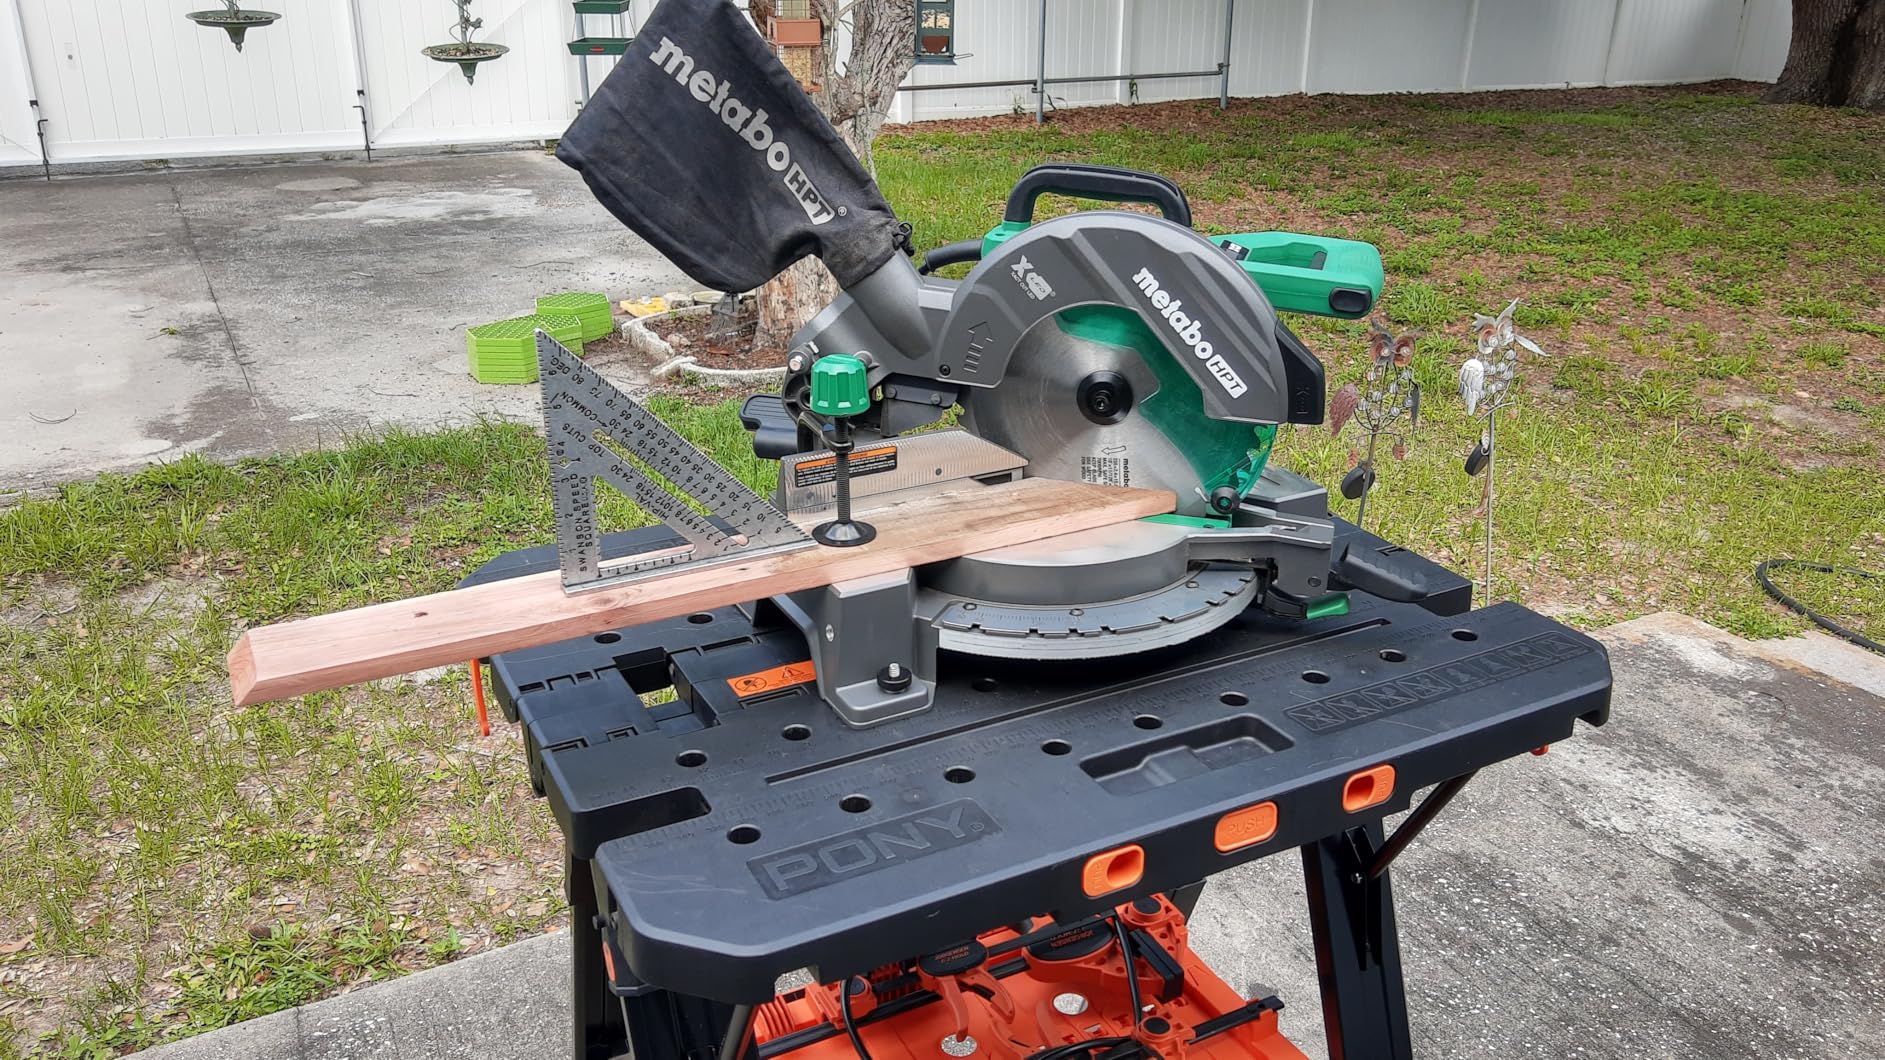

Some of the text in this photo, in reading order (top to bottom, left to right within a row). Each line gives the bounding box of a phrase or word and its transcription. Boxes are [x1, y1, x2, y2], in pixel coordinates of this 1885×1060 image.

[648, 36, 831, 219] metabo HPT
[1132, 267, 1242, 391] metabo HPT
[550, 355, 570, 375] DEG.
[572, 374, 584, 384] 80
[589, 387, 602, 398] 75
[560, 391, 598, 421] COMMON
[606, 400, 617, 410] 70
[620, 410, 632, 420] 65
[609, 418, 621, 429] 30
[633, 420, 645, 430] 60
[621, 428, 633, 438] 24
[645, 430, 658, 440] 55
[637, 440, 648, 449] 18
[658, 439, 669, 448] 50
[648, 448, 658, 457] 15
[669, 447, 680, 456] 45
[661, 457, 671, 467] 12
[681, 456, 691, 465] 40
[562, 423, 669, 520] HIP-VAL TOP CUTS
[611, 465, 622, 475] 30
[672, 465, 682, 474] 10
[691, 464, 703, 474] 35
[622, 473, 634, 482] 24
[704, 473, 715, 483] 30
[636, 483, 647, 492] 18
[716, 482, 727, 492] 25
[645, 489, 655, 498] 15
[729, 492, 740, 501] 20
[655, 496, 666, 505] 12
[664, 503, 674, 511] 10
[742, 502, 752, 511] 15
[570, 473, 588, 572] SWANSON SPEED
[757, 513, 766, 522] 10
[581, 502, 592, 547] SQUARE
[1227, 814, 1265, 834] PUSH
[763, 807, 966, 891] PONY
